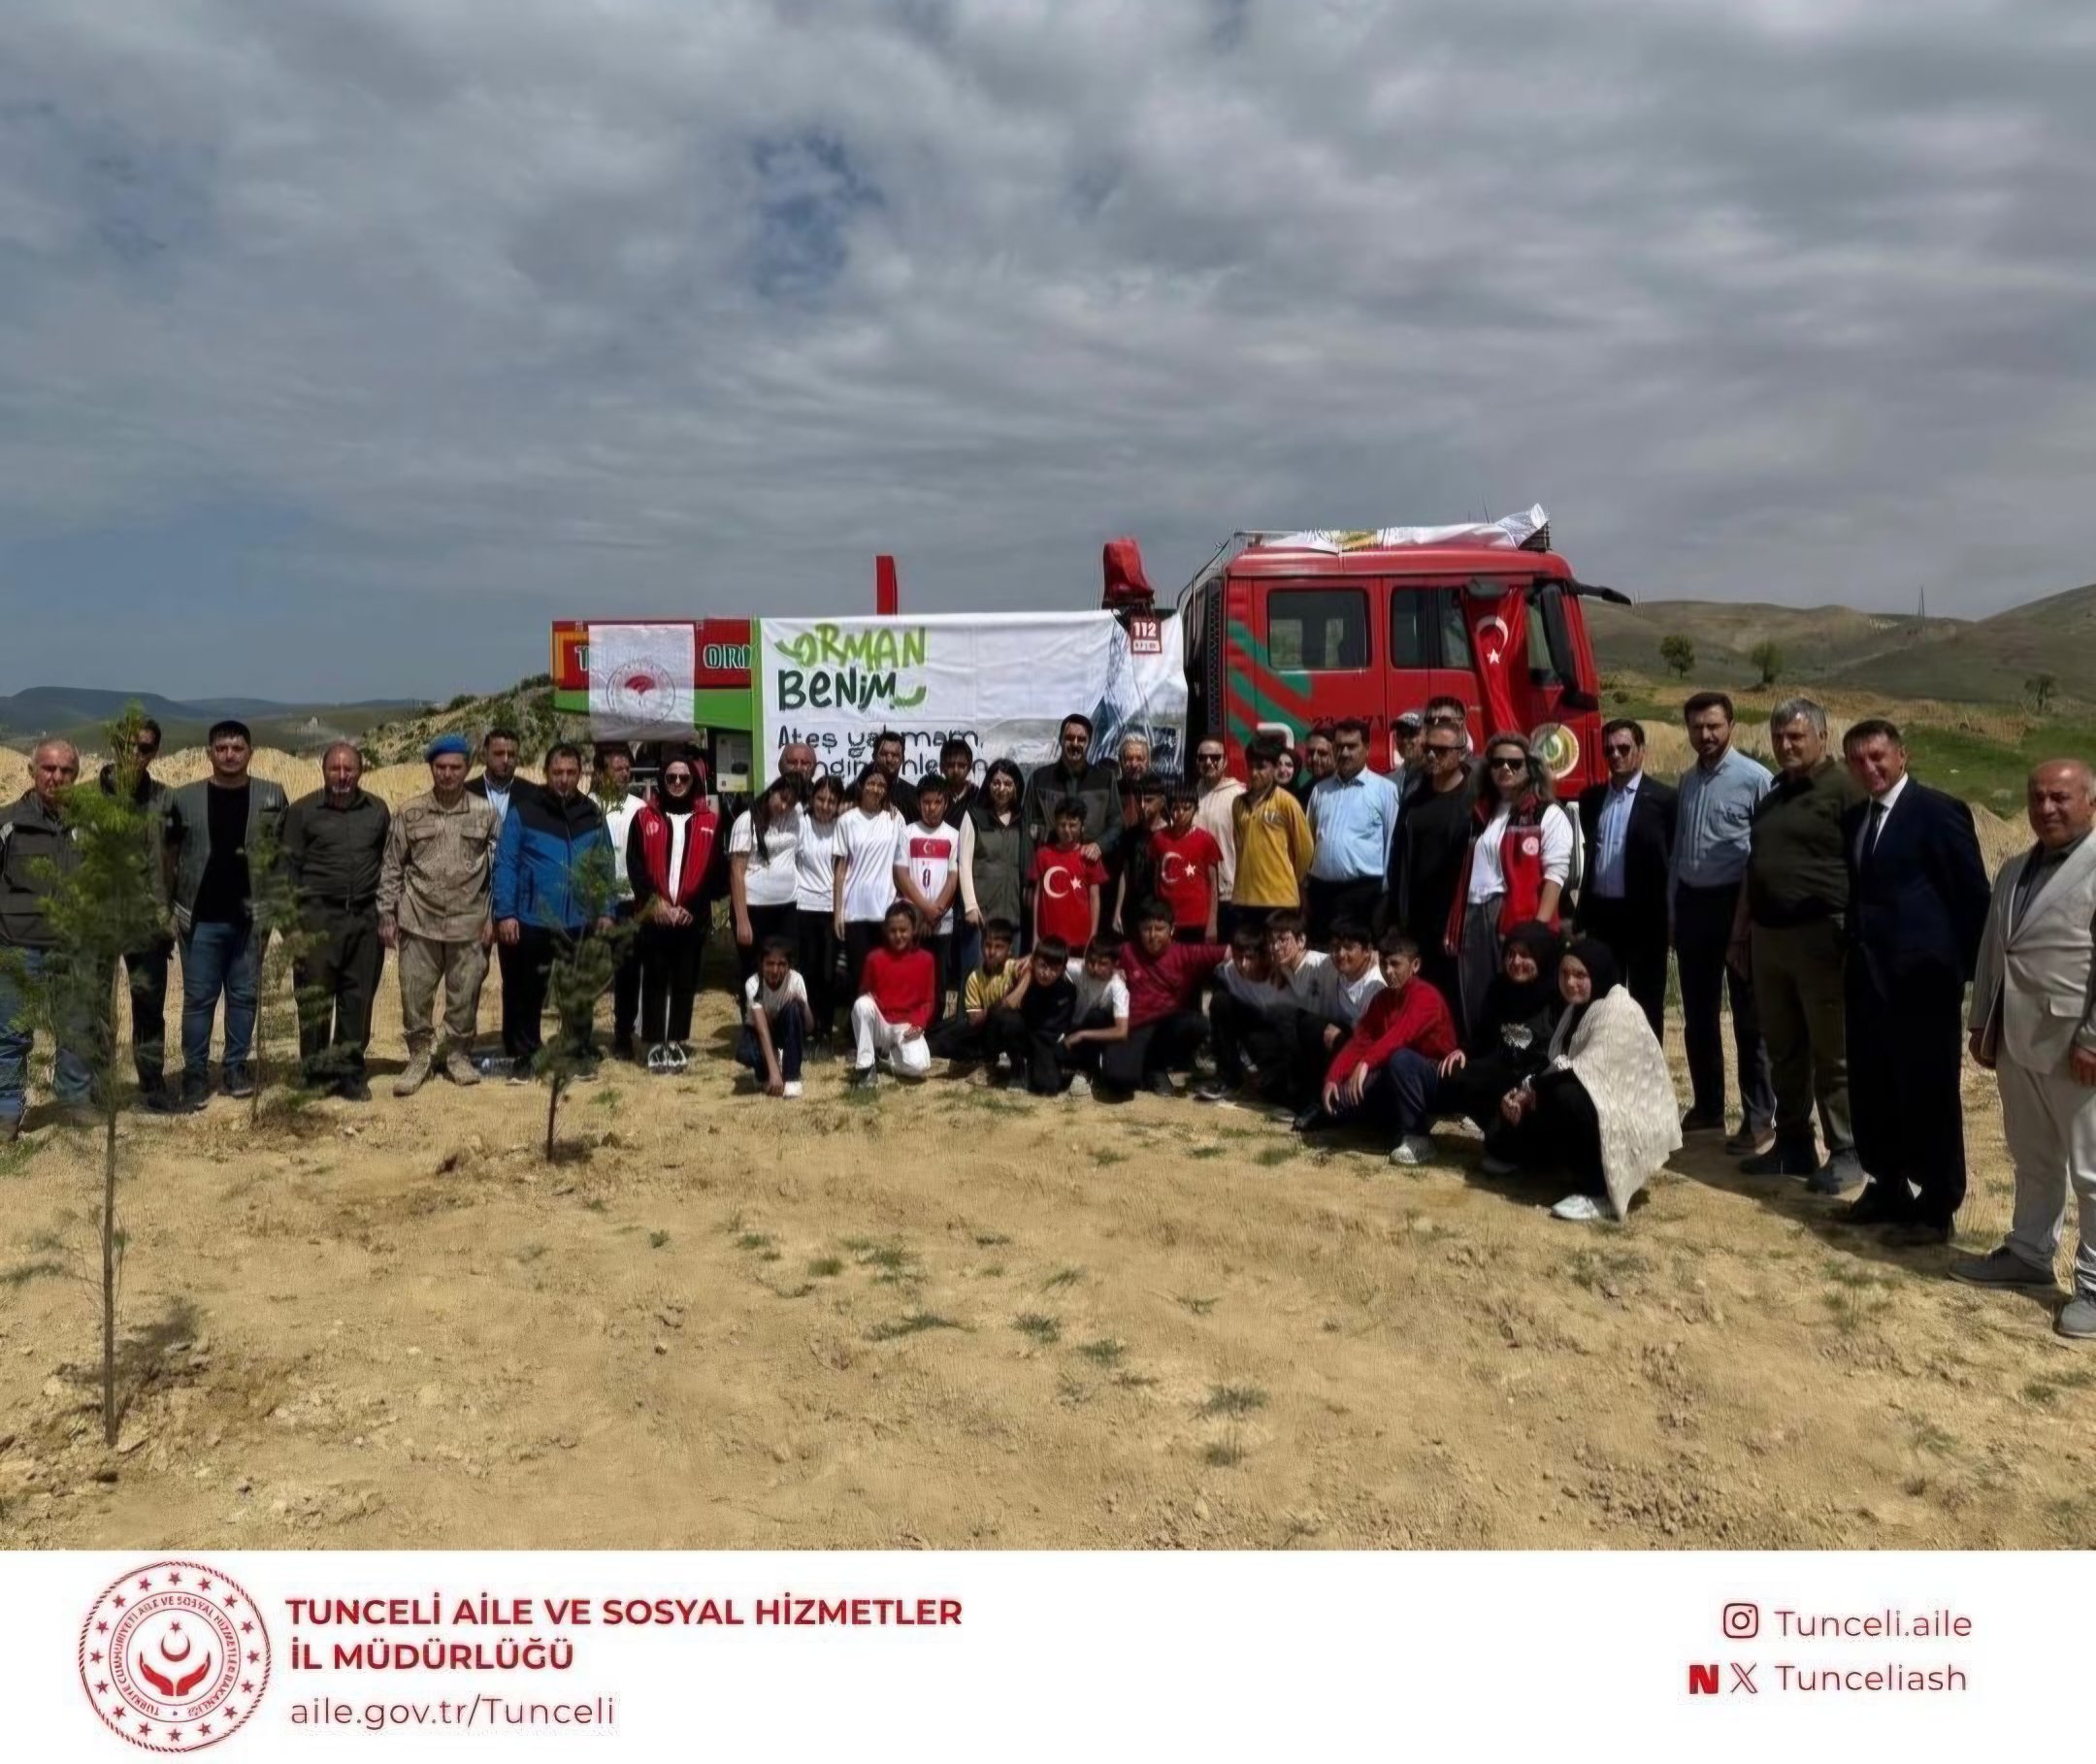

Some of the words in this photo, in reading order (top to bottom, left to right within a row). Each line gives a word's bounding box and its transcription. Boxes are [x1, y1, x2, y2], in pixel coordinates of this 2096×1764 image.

[1133, 622, 1157, 637] 112
[774, 623, 927, 671] ORMAN
[777, 725, 838, 755] Ateş
